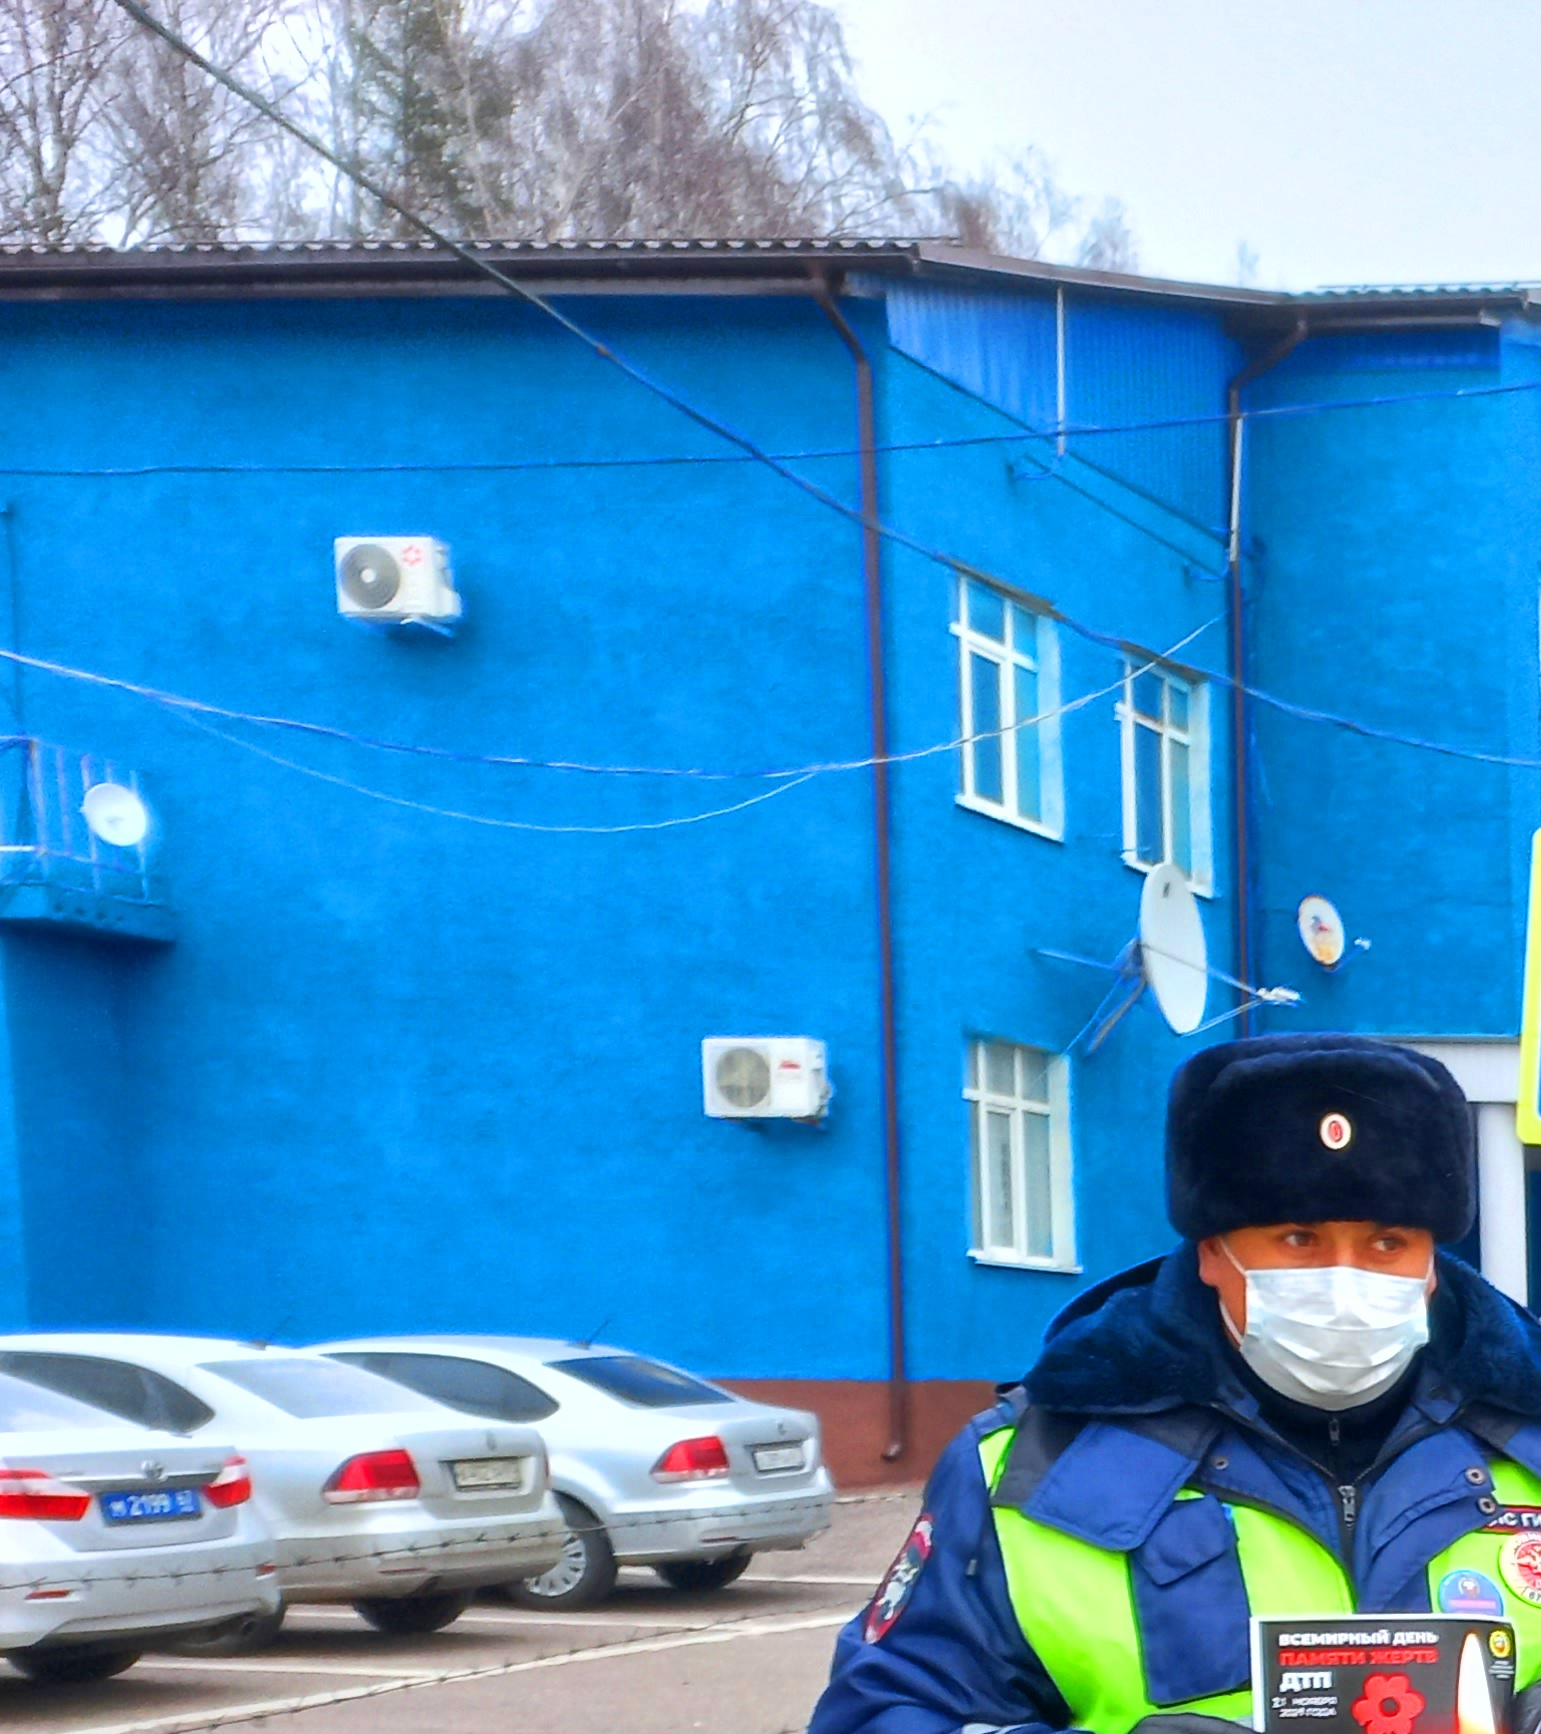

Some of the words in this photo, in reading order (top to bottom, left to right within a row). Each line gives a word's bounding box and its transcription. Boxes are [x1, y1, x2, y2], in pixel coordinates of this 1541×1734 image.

[1278, 1629, 1391, 1647] ВСЕМИРНЫЙ
[1392, 1631, 1440, 1647] ДЕНЬ
[1279, 1650, 1367, 1666] ПАМЯТИ
[1369, 1650, 1439, 1665] ЖЕРТВ
[1279, 1671, 1333, 1693] ДТП
